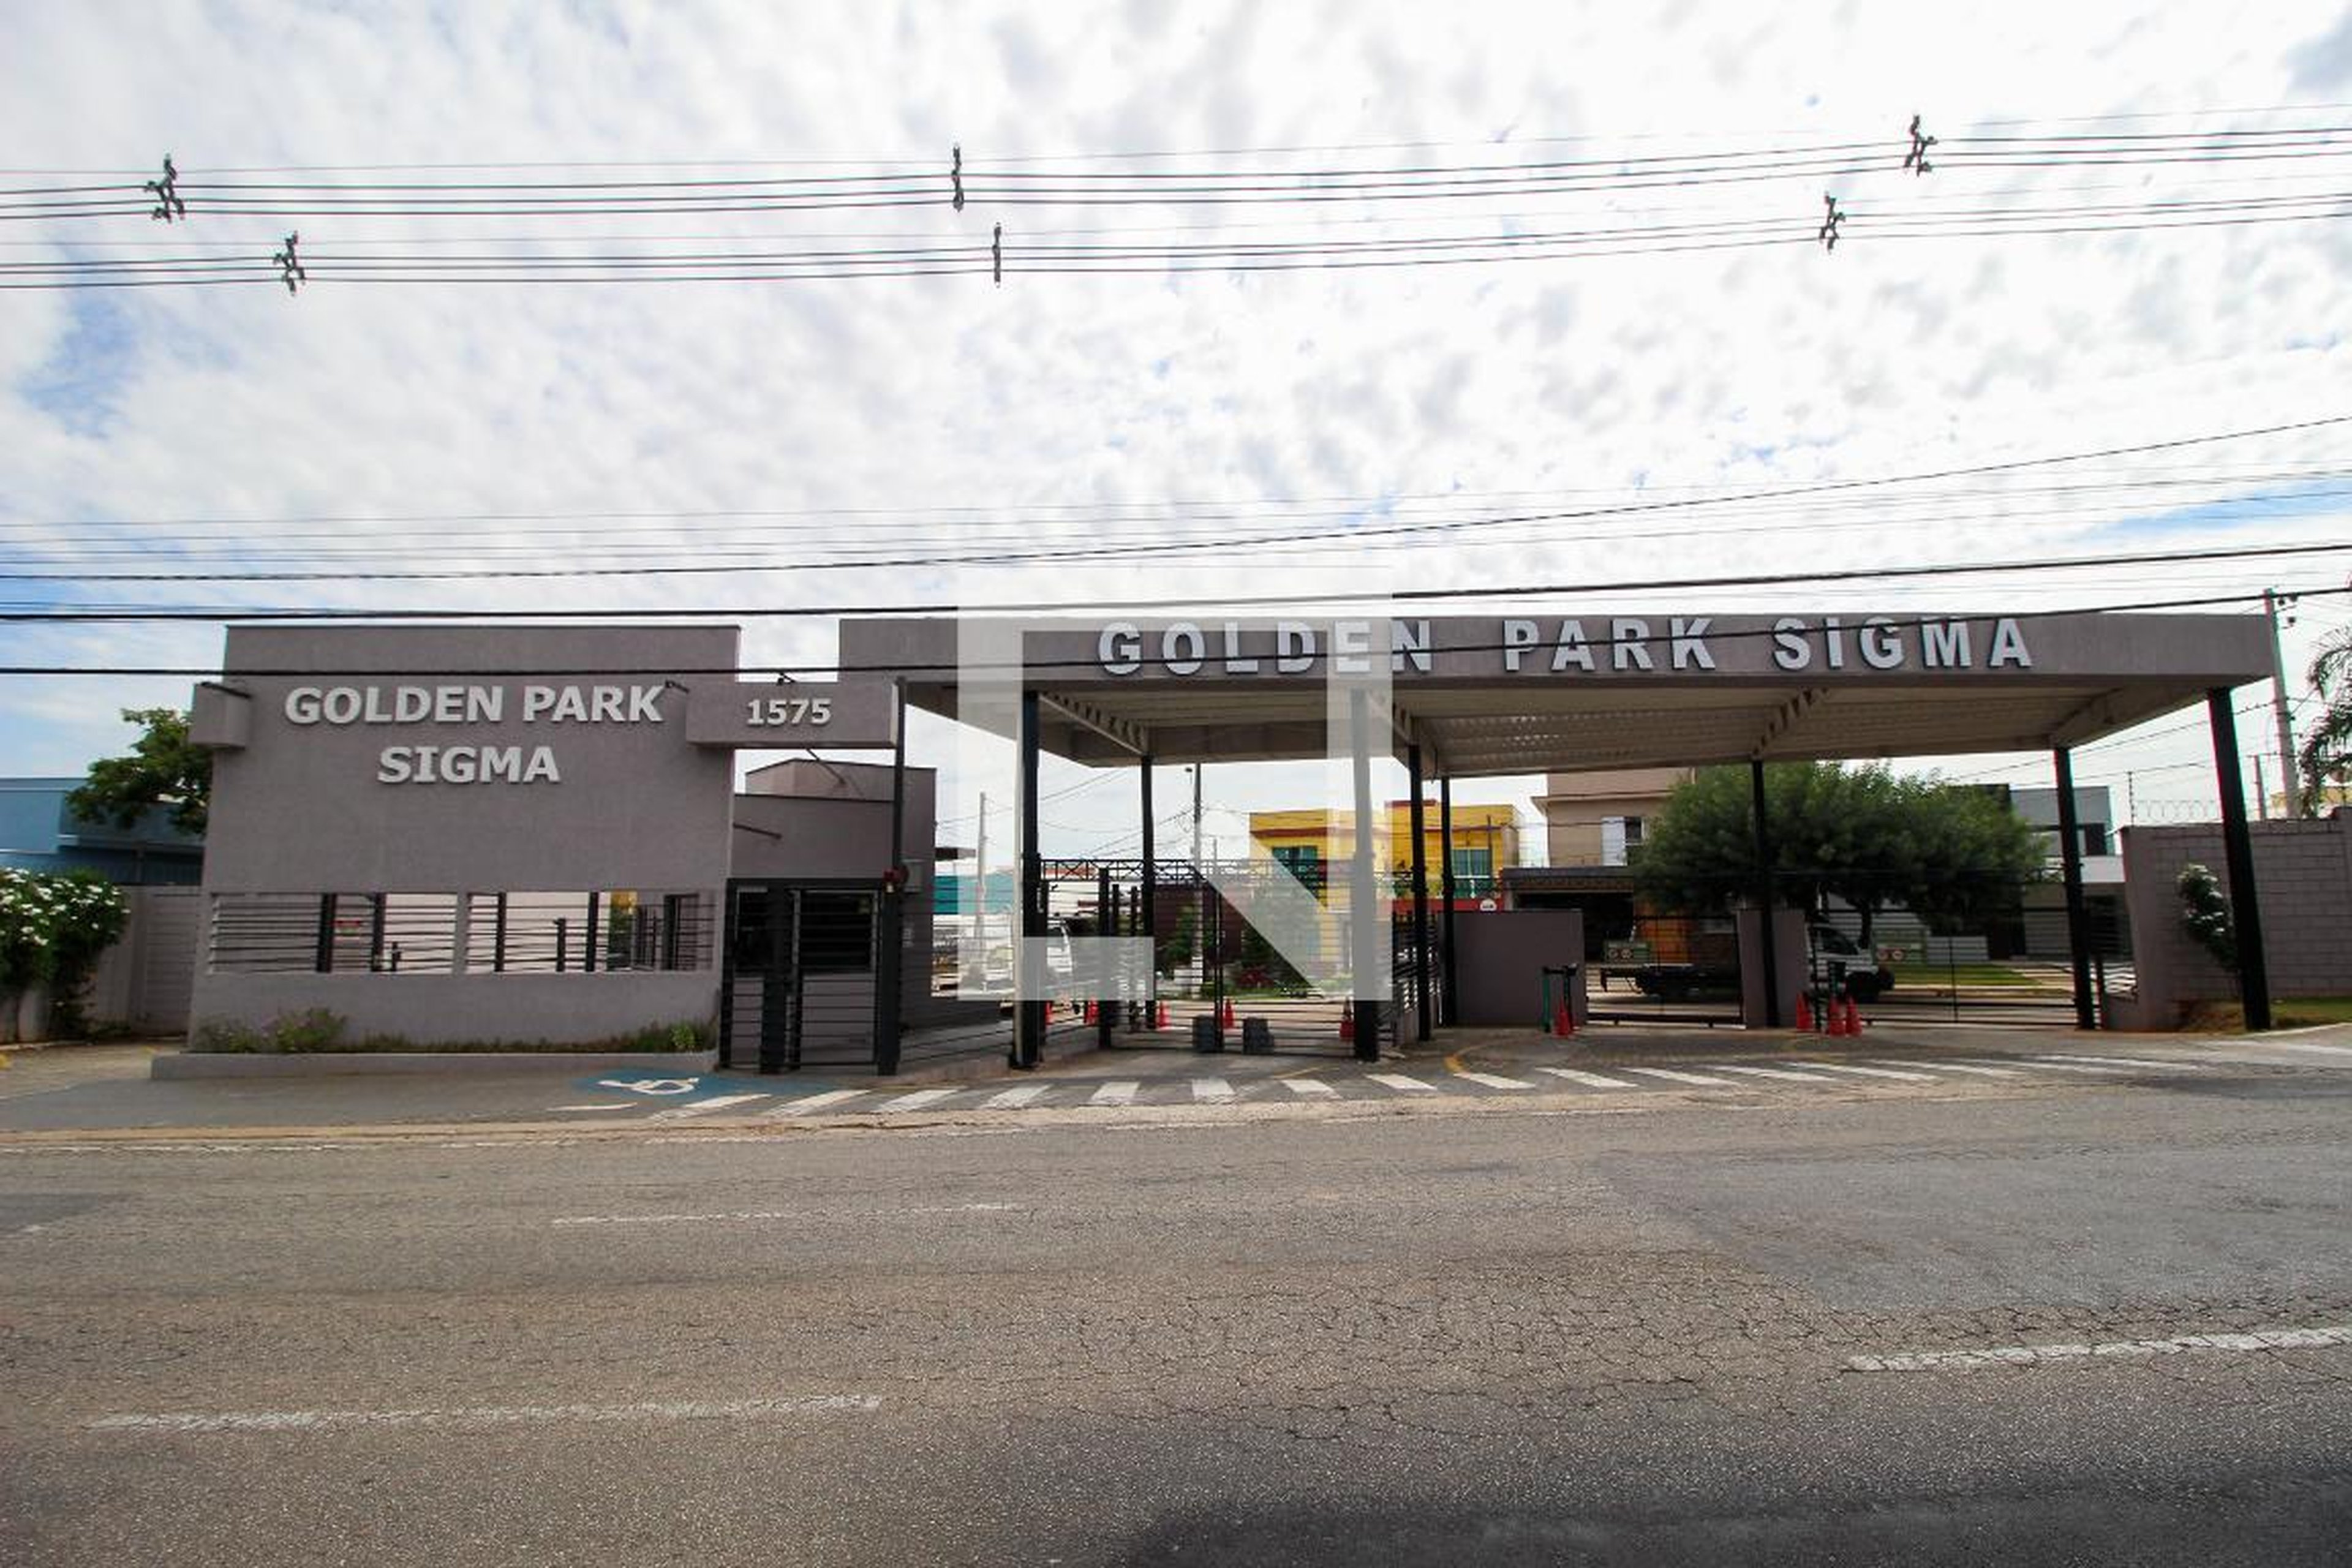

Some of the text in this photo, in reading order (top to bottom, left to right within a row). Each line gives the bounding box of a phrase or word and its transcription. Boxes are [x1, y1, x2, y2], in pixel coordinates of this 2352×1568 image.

[1098, 616, 2032, 674] GOLDEN PARK SIGMA
[285, 685, 664, 723] GOLDEN PARK
[747, 698, 832, 725] 1575
[377, 746, 560, 783] SIGMA
